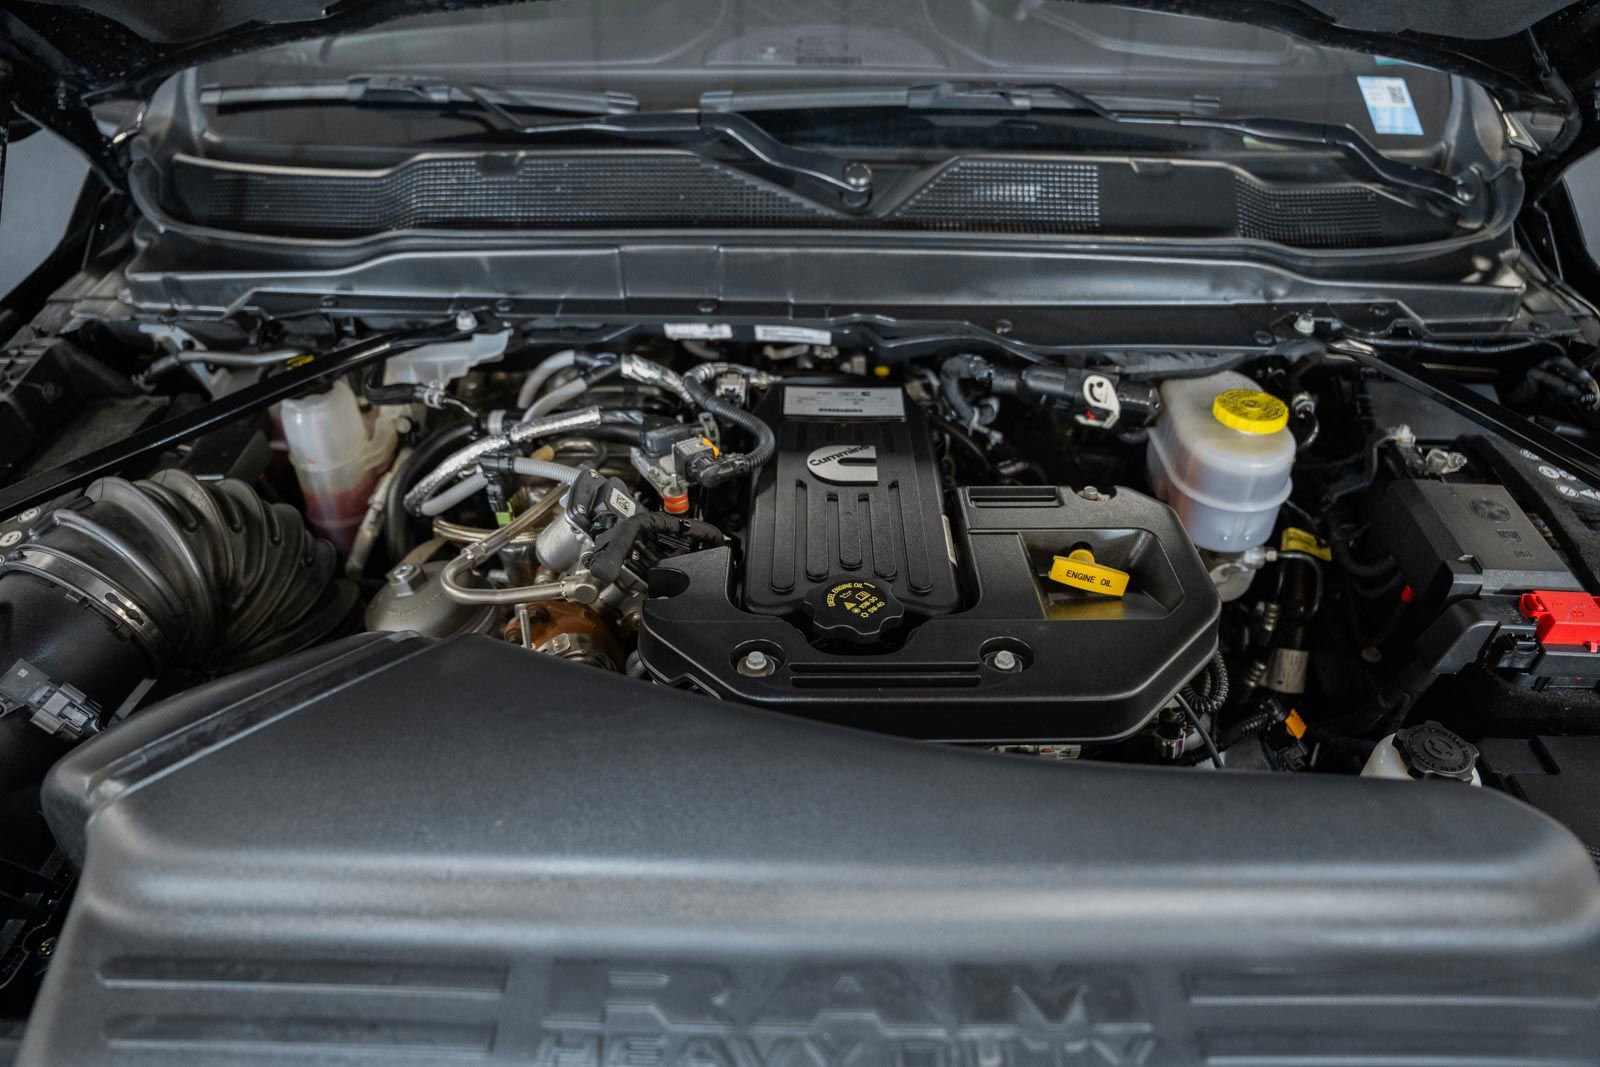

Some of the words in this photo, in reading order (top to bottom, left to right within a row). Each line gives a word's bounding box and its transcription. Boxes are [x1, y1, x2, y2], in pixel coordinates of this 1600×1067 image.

[808, 443, 871, 467] Cummins
[1065, 569, 1097, 585] ENGINE
[1100, 578, 1113, 589] OIL
[826, 592, 836, 607] DIESEL
[831, 582, 853, 594] ENGINE
[541, 957, 1155, 1036] RAM
